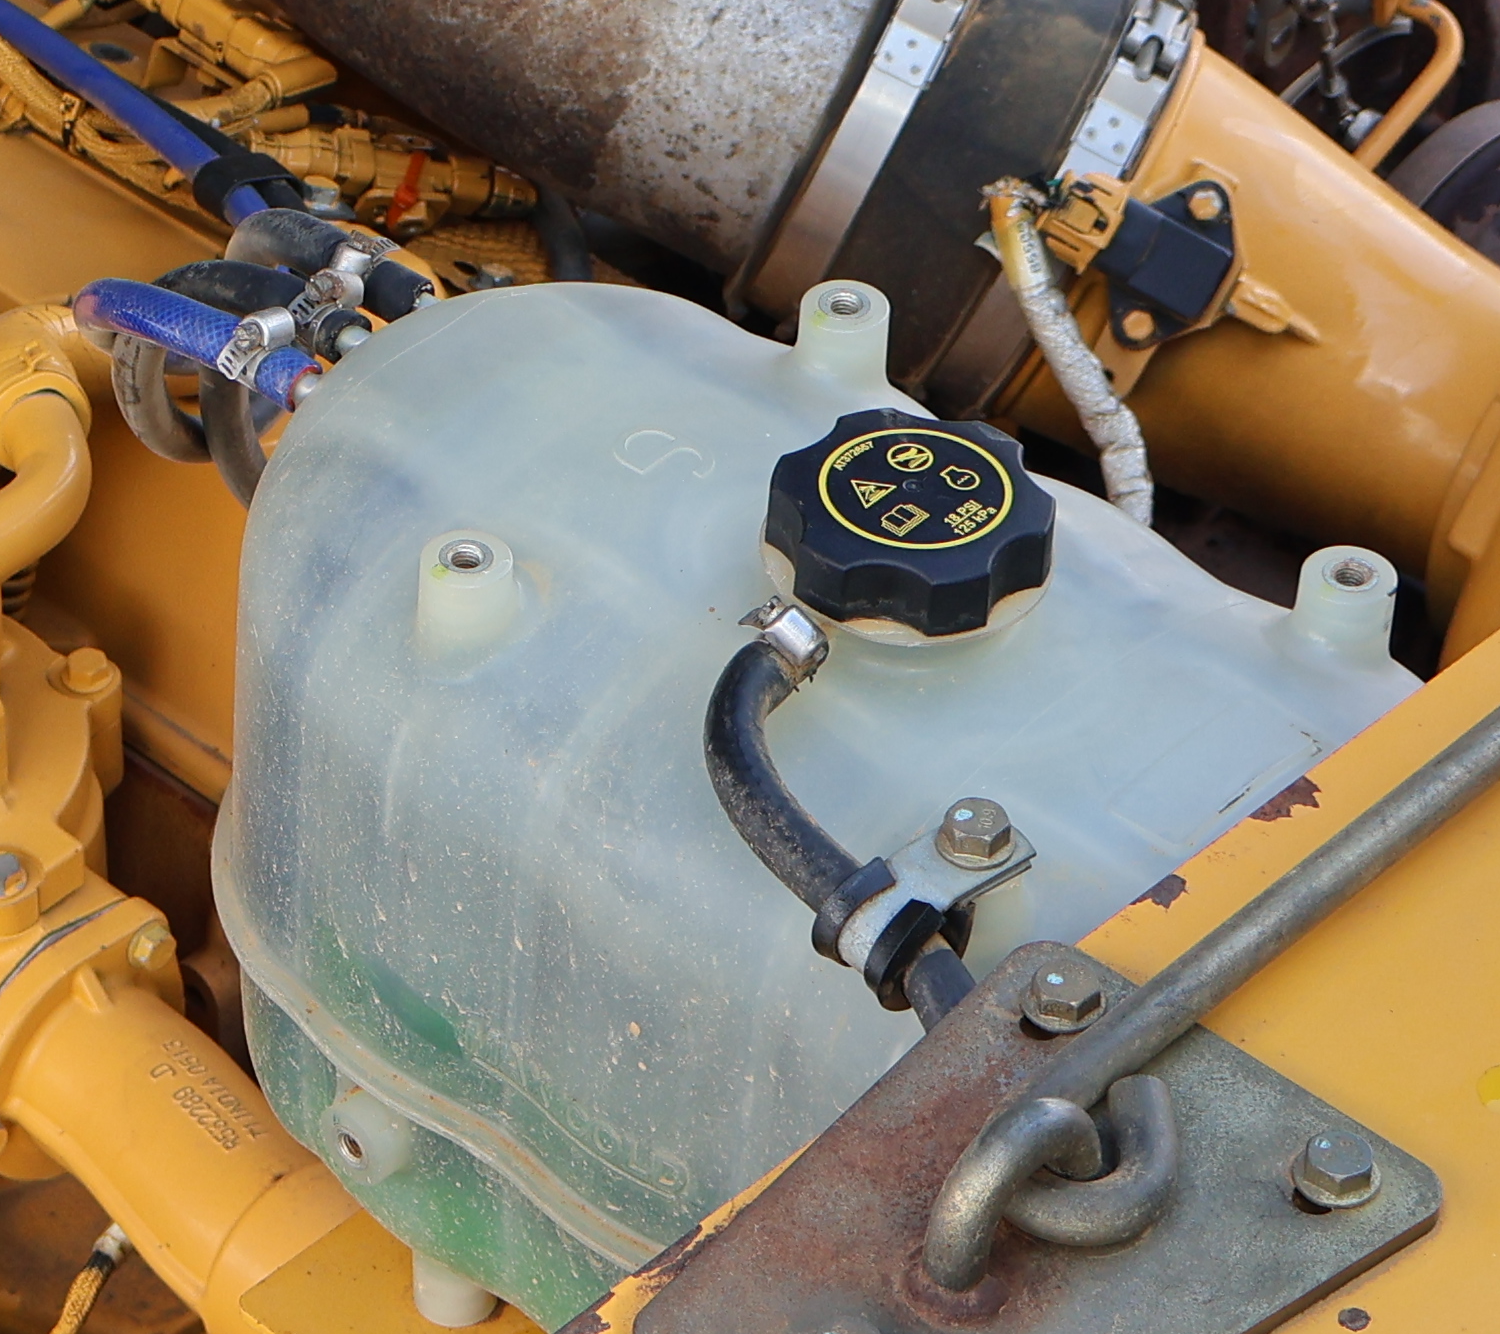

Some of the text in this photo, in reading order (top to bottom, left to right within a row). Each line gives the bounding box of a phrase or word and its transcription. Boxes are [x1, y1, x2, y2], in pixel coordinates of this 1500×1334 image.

[943, 498, 980, 525] 18 PSI
[953, 506, 998, 535] 125 kPa
